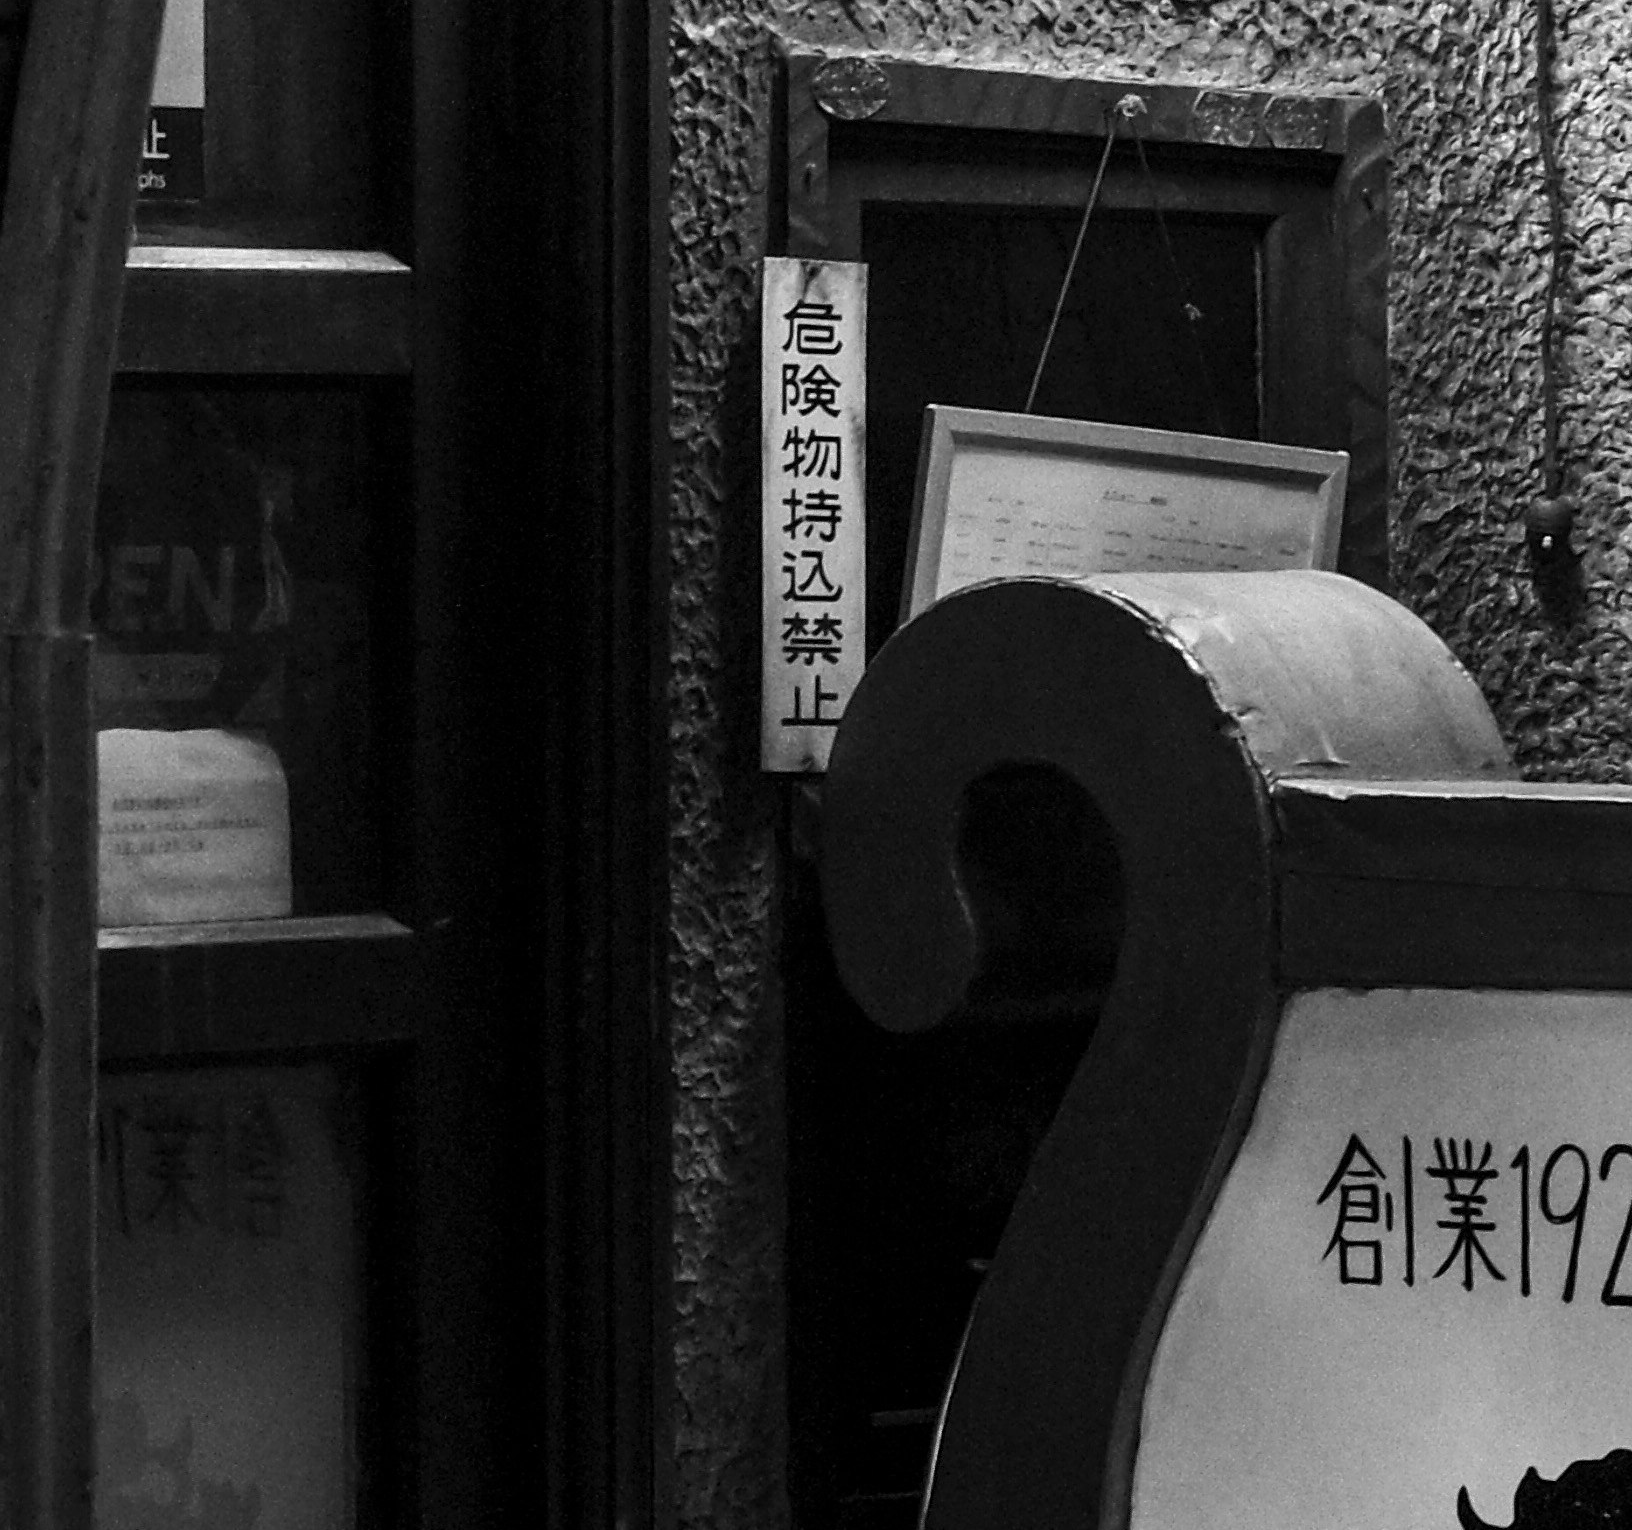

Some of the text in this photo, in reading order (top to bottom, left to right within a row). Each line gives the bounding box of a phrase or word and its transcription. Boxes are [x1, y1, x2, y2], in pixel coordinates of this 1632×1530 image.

[99, 543, 237, 631] EN
[781, 301, 843, 728] 危険物持込禁止
